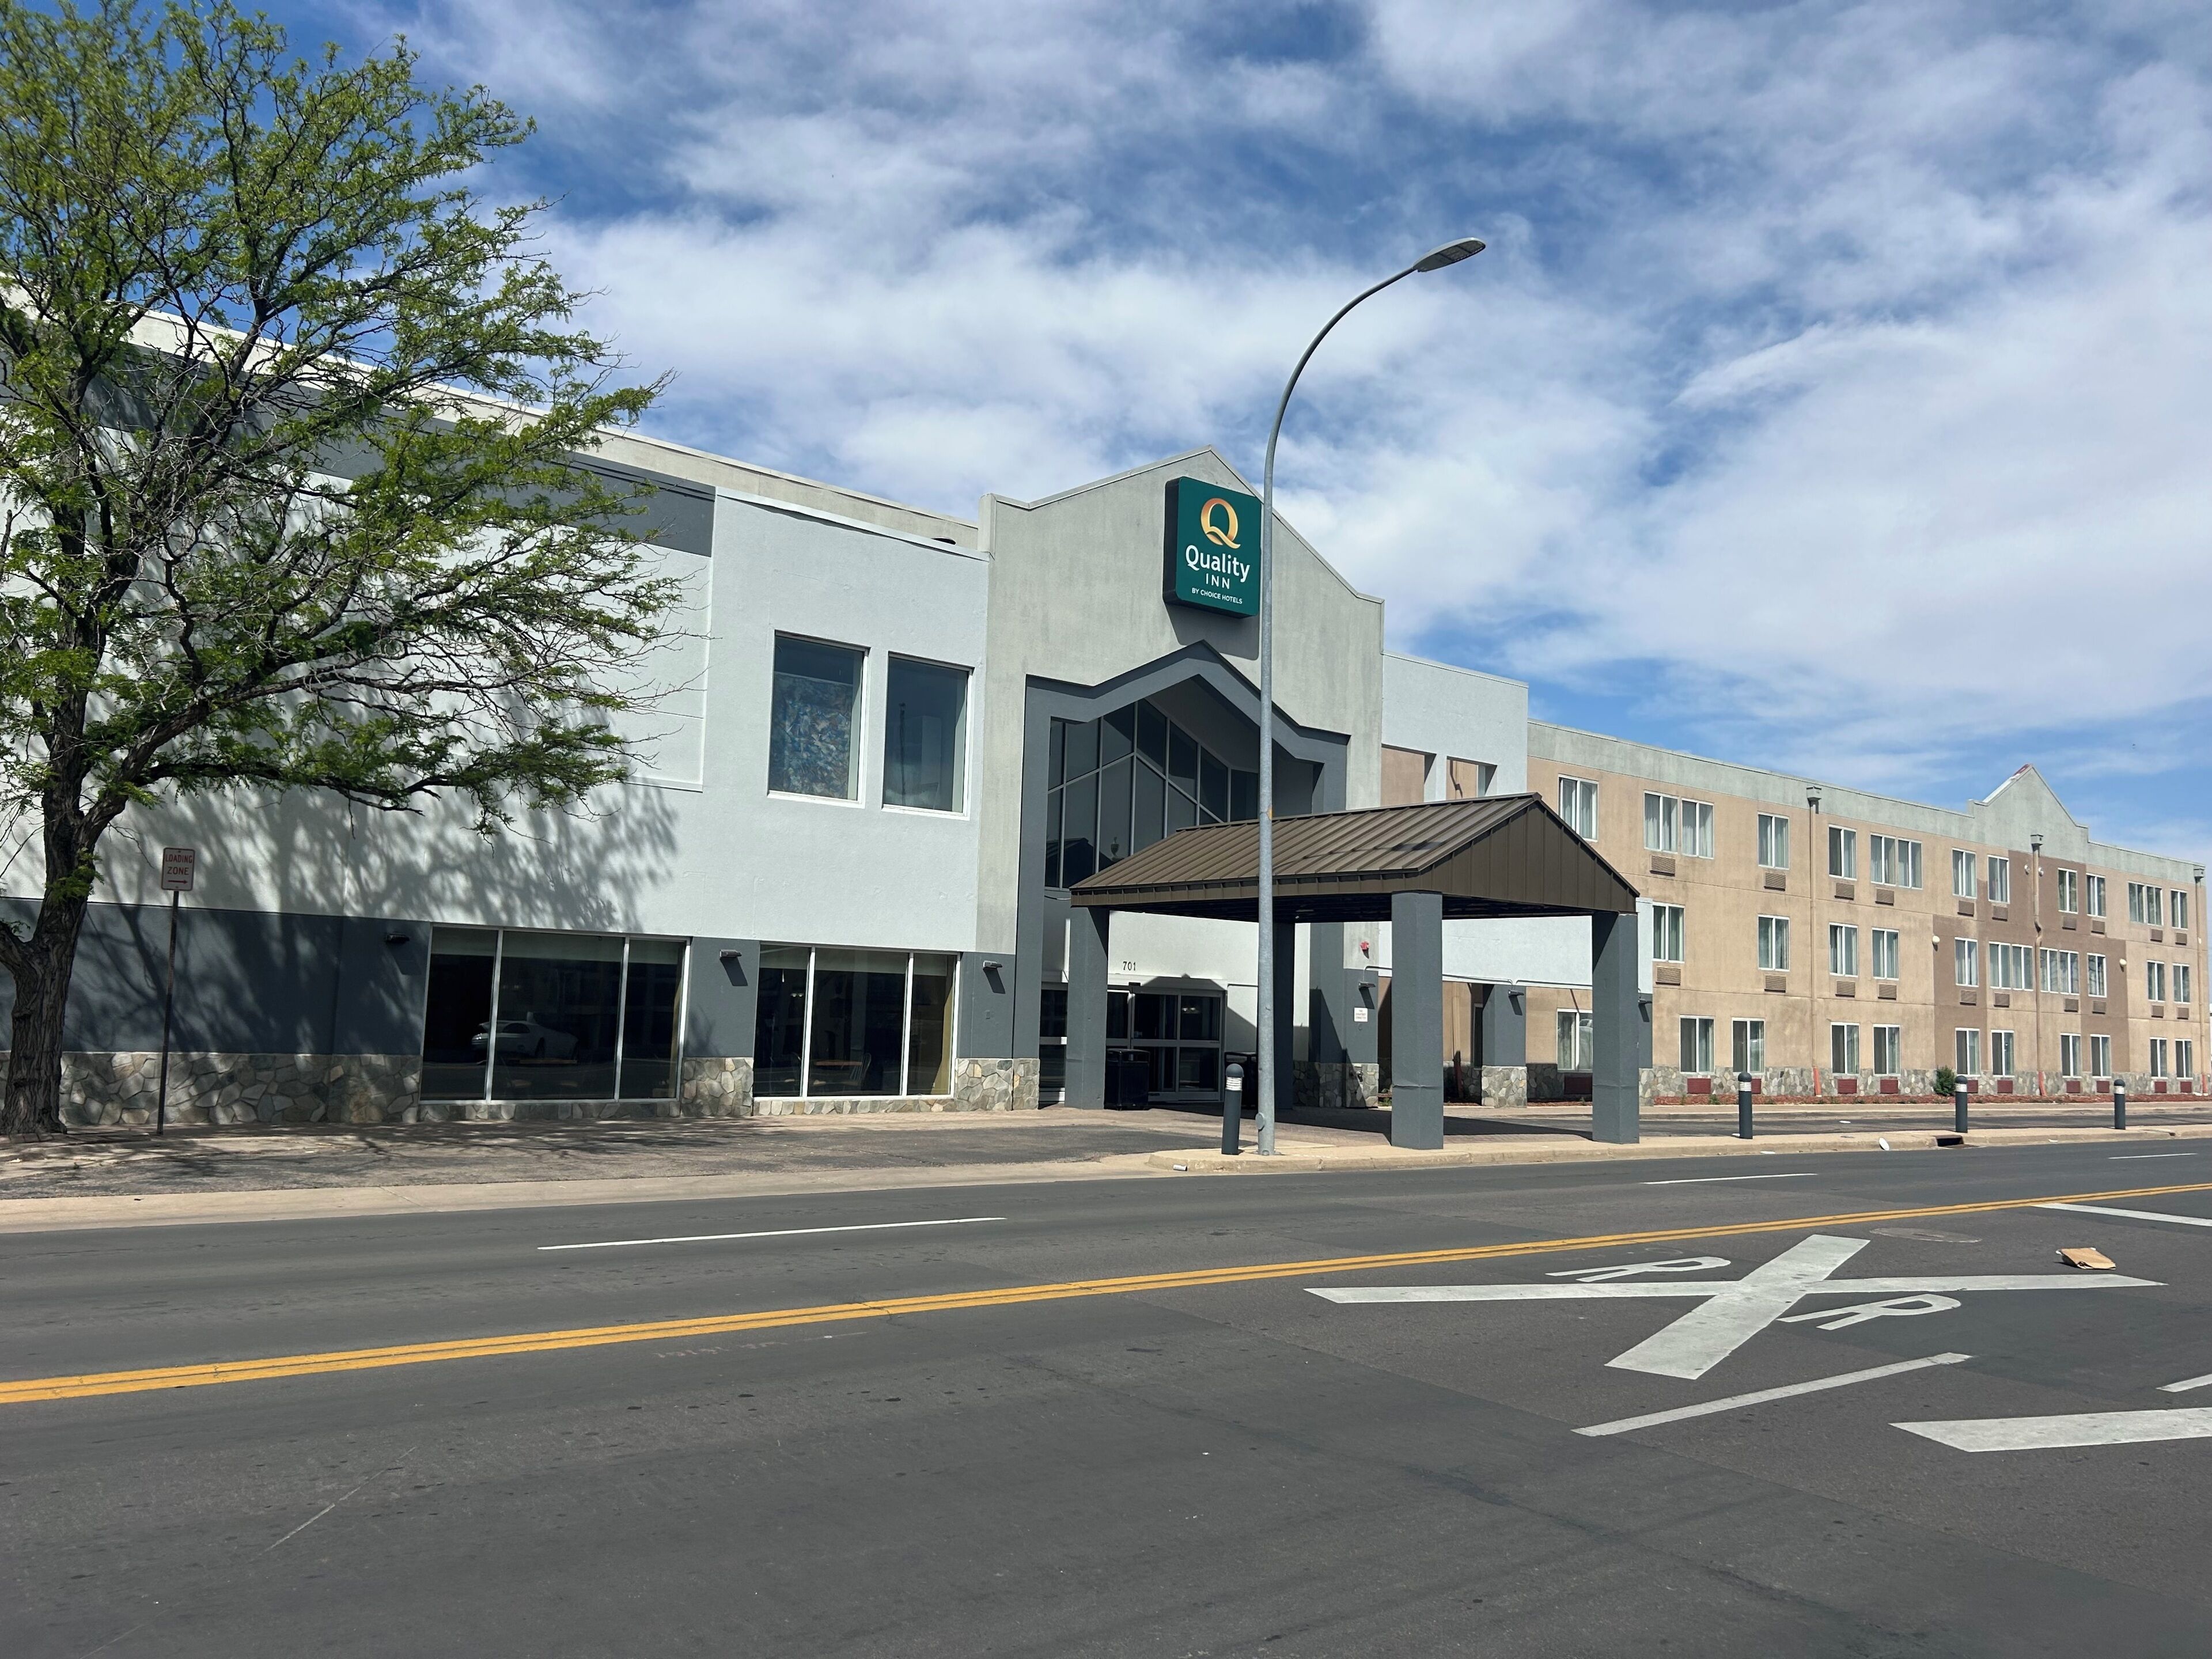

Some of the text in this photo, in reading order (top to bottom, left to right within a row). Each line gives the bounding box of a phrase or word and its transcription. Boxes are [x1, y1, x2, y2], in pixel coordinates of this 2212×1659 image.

[1200, 498, 1241, 549] Q
[1185, 545, 1250, 582] Quality
[1206, 573, 1230, 589] INN
[1200, 589, 1221, 600] CHOICE
[1222, 596, 1243, 604] HOTELS
[165, 854, 192, 863] LOADING
[167, 866, 189, 875] ZONE
[1123, 961, 1136, 971] 701
[1545, 1256, 1731, 1282] R
[1777, 1294, 1961, 1331] R
